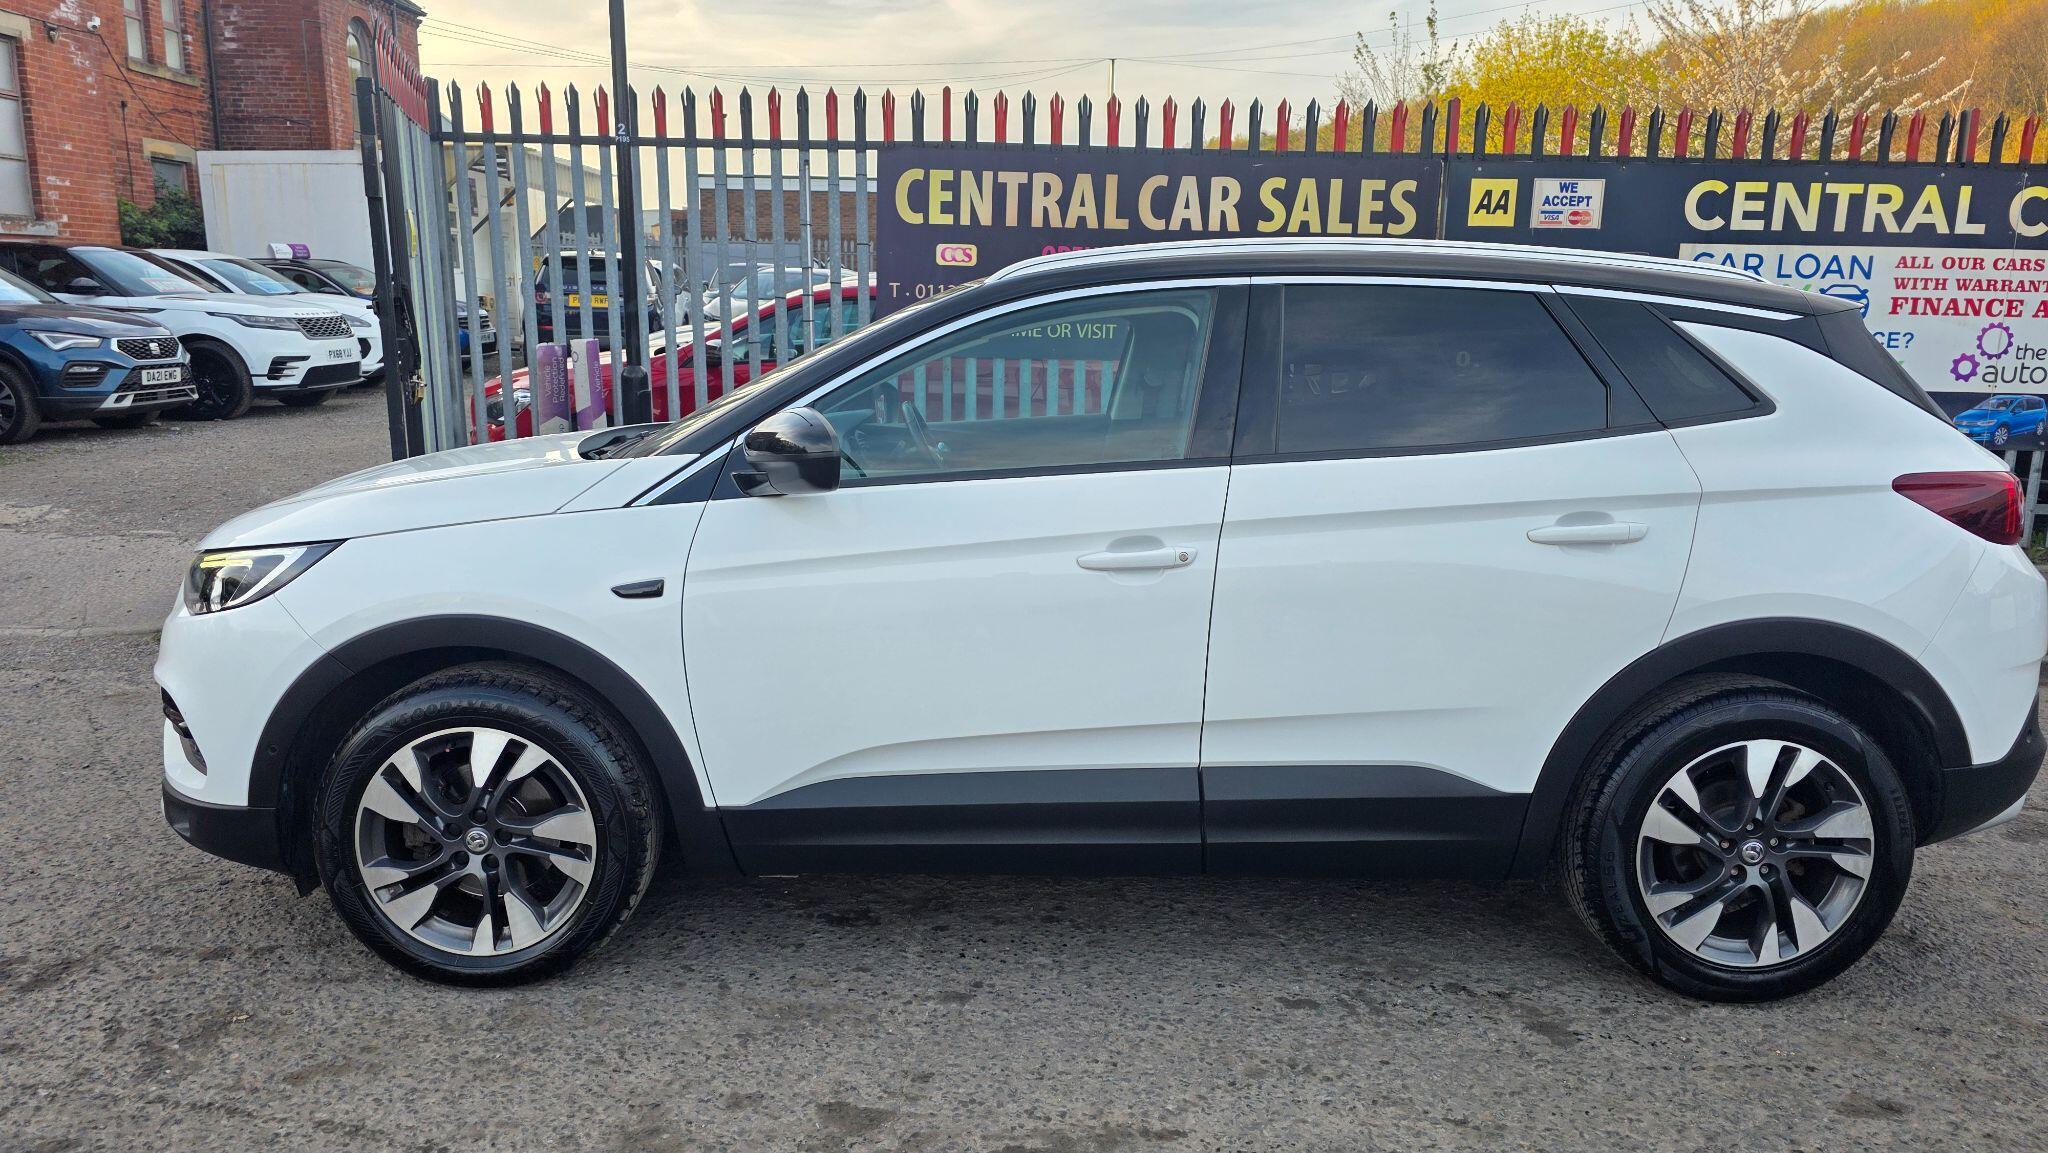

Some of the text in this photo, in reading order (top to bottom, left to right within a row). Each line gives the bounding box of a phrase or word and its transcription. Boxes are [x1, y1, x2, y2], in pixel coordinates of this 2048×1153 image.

[617, 123, 626, 135] 2
[1559, 181, 1579, 193] WE
[895, 168, 1417, 235] CENTRAL CAR SALES
[1473, 189, 1510, 215] AA
[1541, 195, 1592, 207] ACCEPT
[1684, 179, 1986, 235] CENTRAL
[1776, 253, 1874, 280] LOAN
[1895, 256, 2045, 271] ALL OUR CARS
[1893, 277, 1949, 291] WITH
[1888, 296, 2024, 318] FINANCE
[1047, 324, 1071, 338] OR
[1076, 323, 1117, 339] VISIT
[2015, 343, 2048, 361] the
[146, 370, 163, 382] DA21
[544, 365, 552, 397] Vehicle
[552, 357, 560, 403] Protection
[593, 361, 601, 393] Vehicle
[1981, 362, 2048, 384] auto
